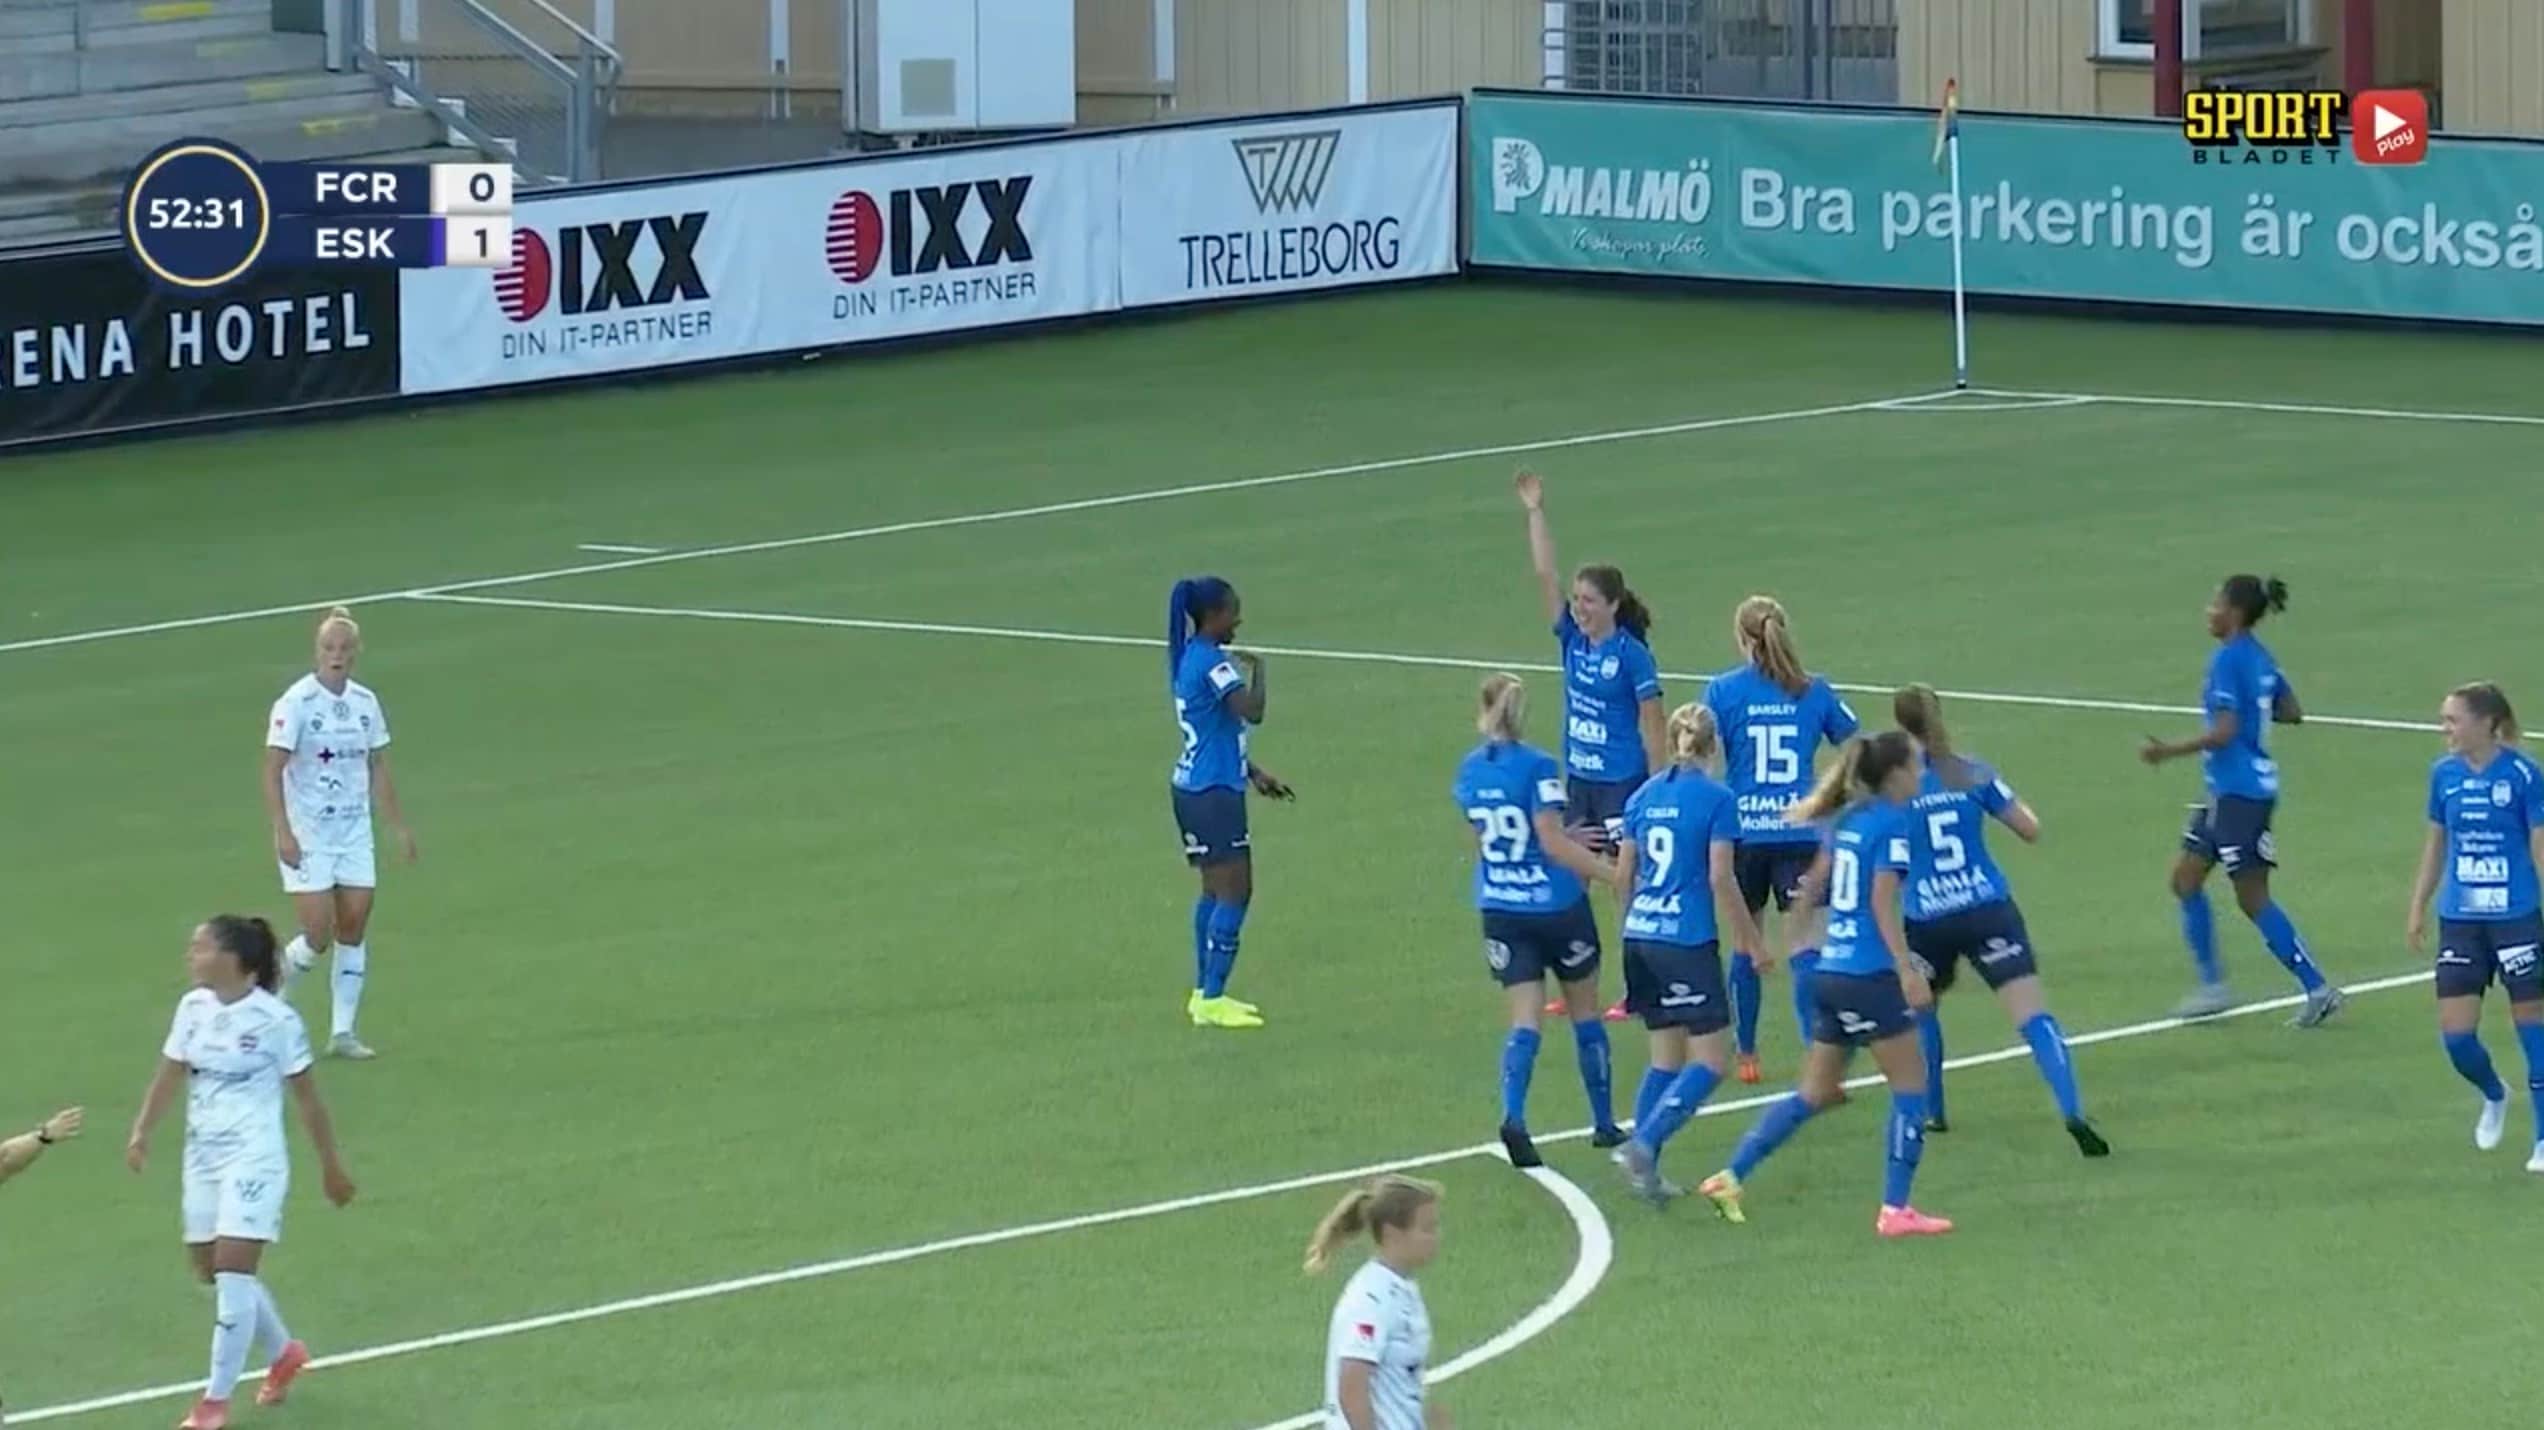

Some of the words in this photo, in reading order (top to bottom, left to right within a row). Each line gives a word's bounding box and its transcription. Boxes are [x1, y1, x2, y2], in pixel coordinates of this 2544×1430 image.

[890, 175, 1033, 277] IXX
[1740, 168, 1856, 233] Bra
[1882, 180, 2213, 267] parkering
[2240, 192, 2312, 257] är
[2336, 202, 2544, 271] också
[559, 212, 709, 316] IXX
[1179, 217, 1400, 289] TRELLEBORG
[833, 291, 877, 319] DIN
[890, 272, 1037, 312] IT-PARTNER
[0, 319, 135, 388] ENA
[169, 293, 370, 369] HOTEL
[503, 329, 547, 359] DIN
[560, 311, 712, 352] IT-PARTNER
[1747, 725, 1799, 784] 15
[1467, 805, 1530, 862] 29
[1647, 826, 1674, 887] 9
[1928, 811, 1966, 872] 5
